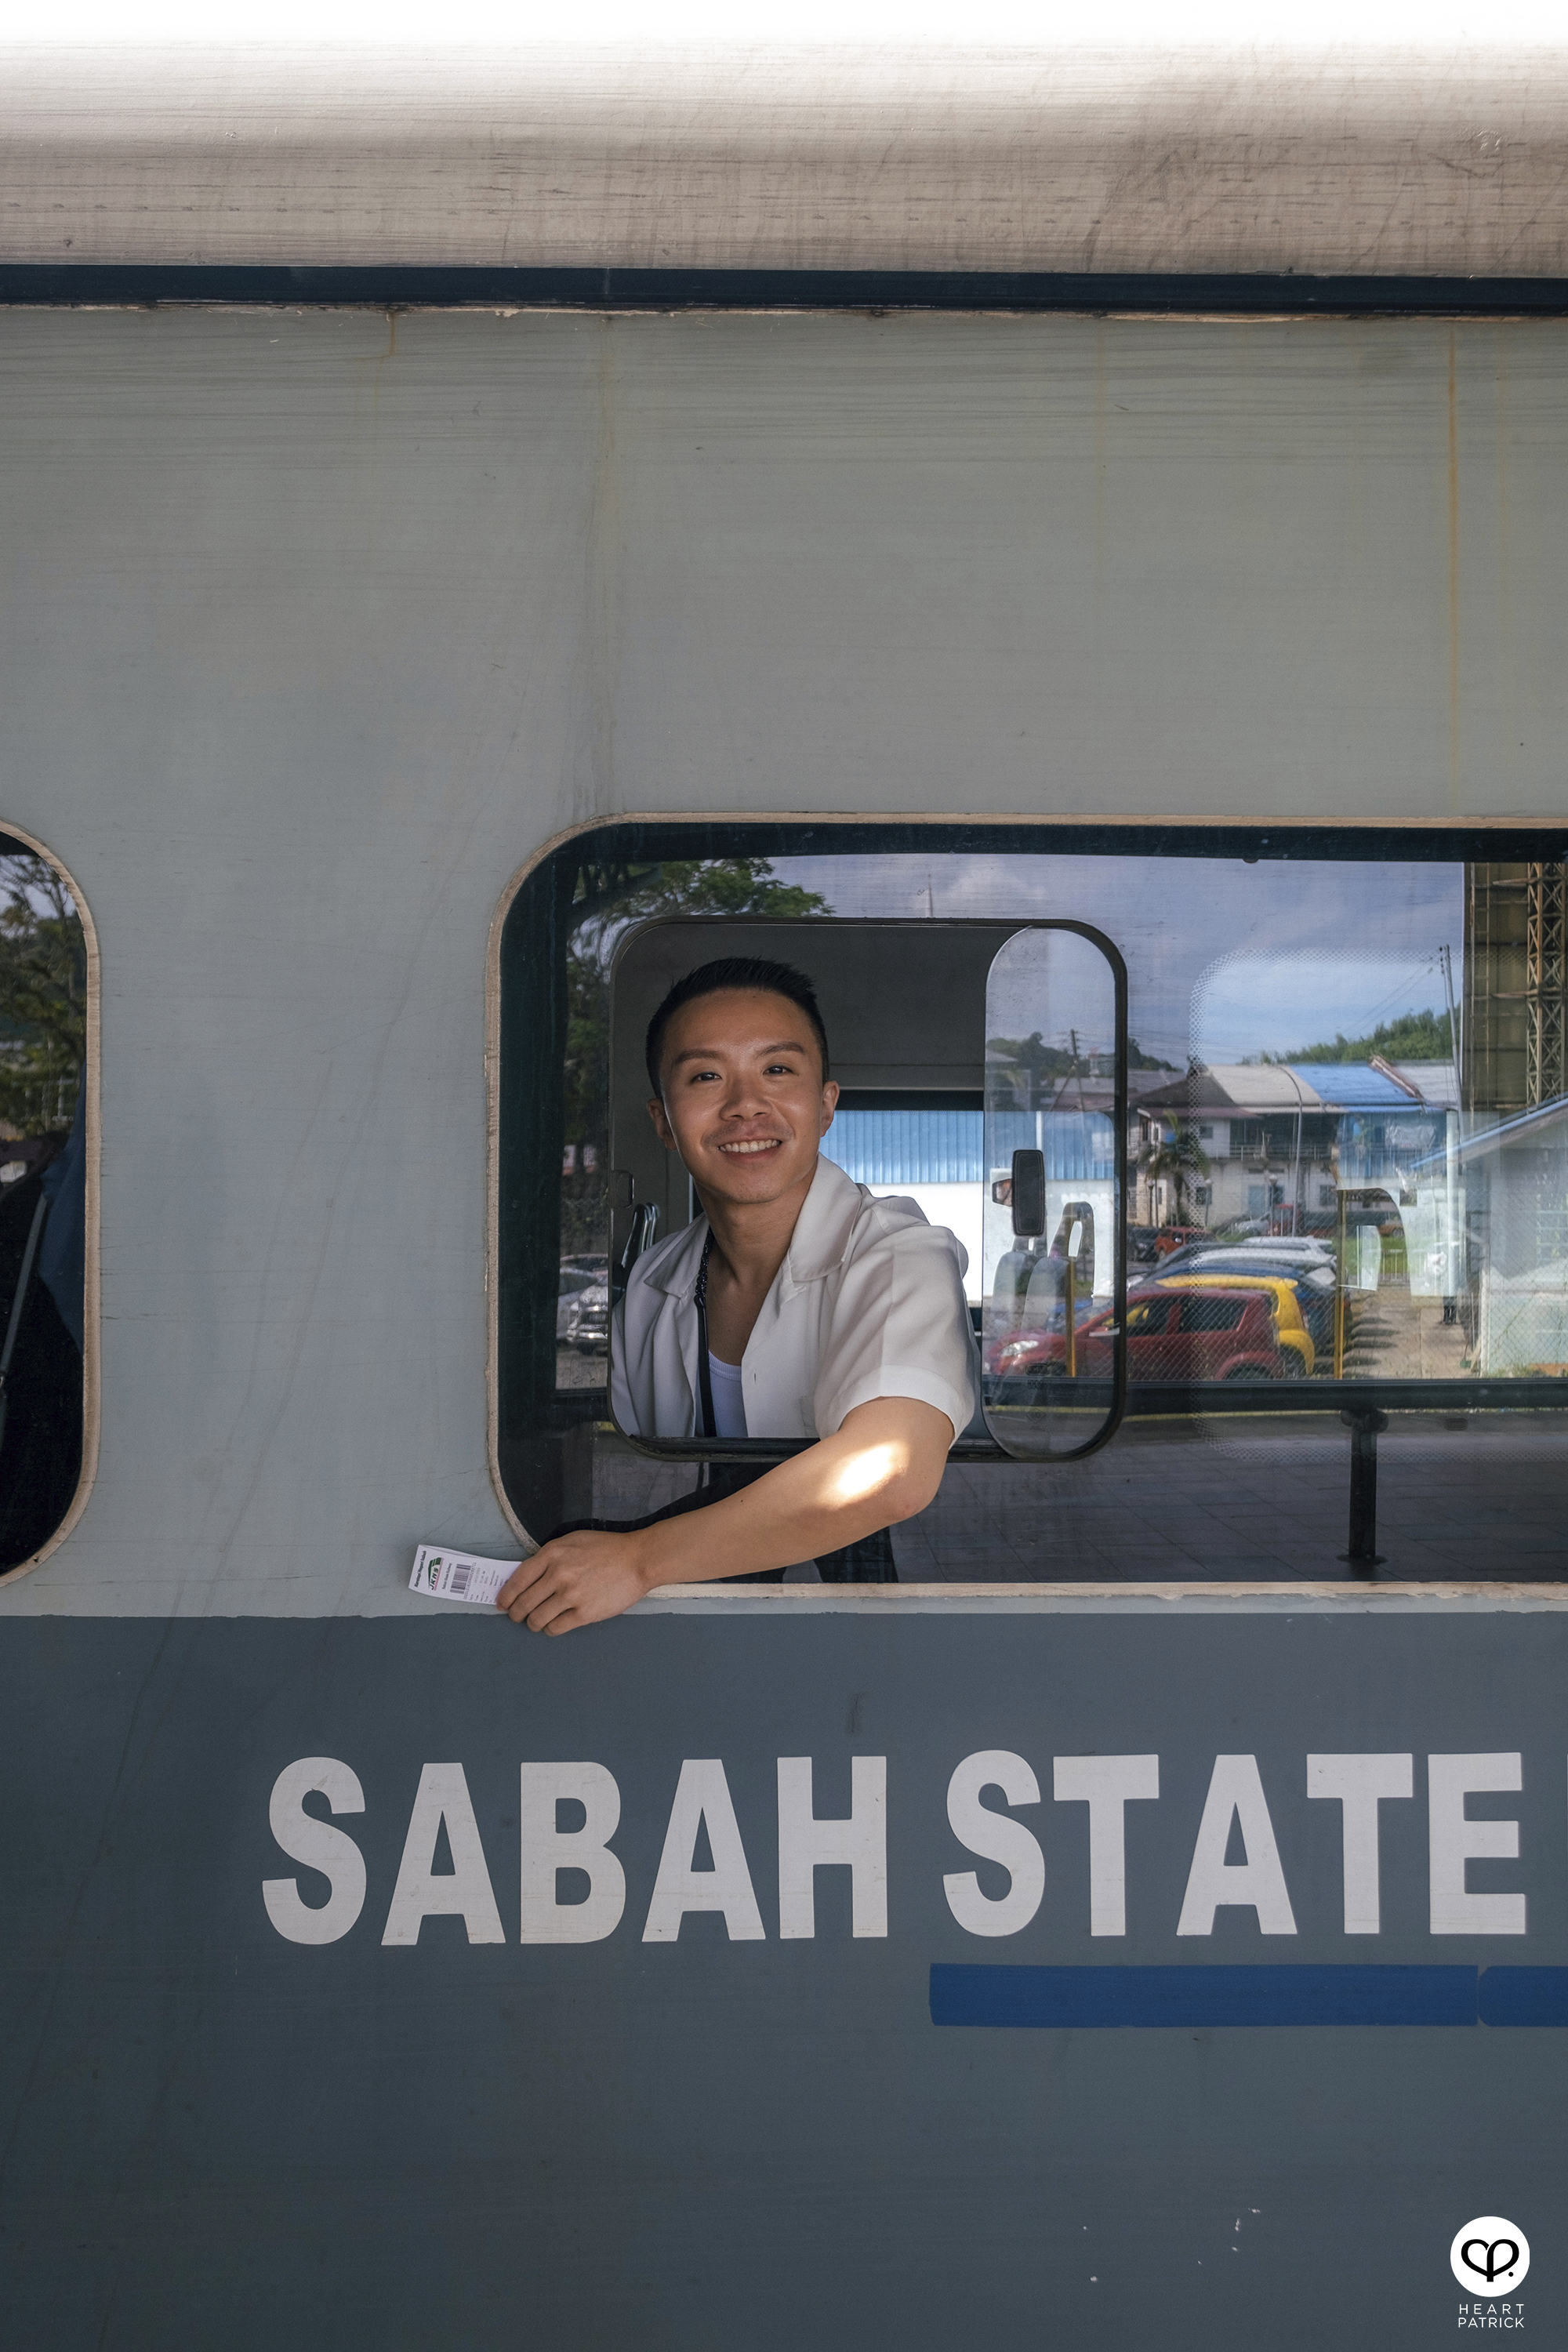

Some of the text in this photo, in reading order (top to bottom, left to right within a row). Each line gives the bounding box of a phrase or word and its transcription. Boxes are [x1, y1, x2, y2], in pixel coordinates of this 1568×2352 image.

[429, 1567, 439, 1590] JKNS
[262, 1749, 1526, 1946] SABAH STATE
